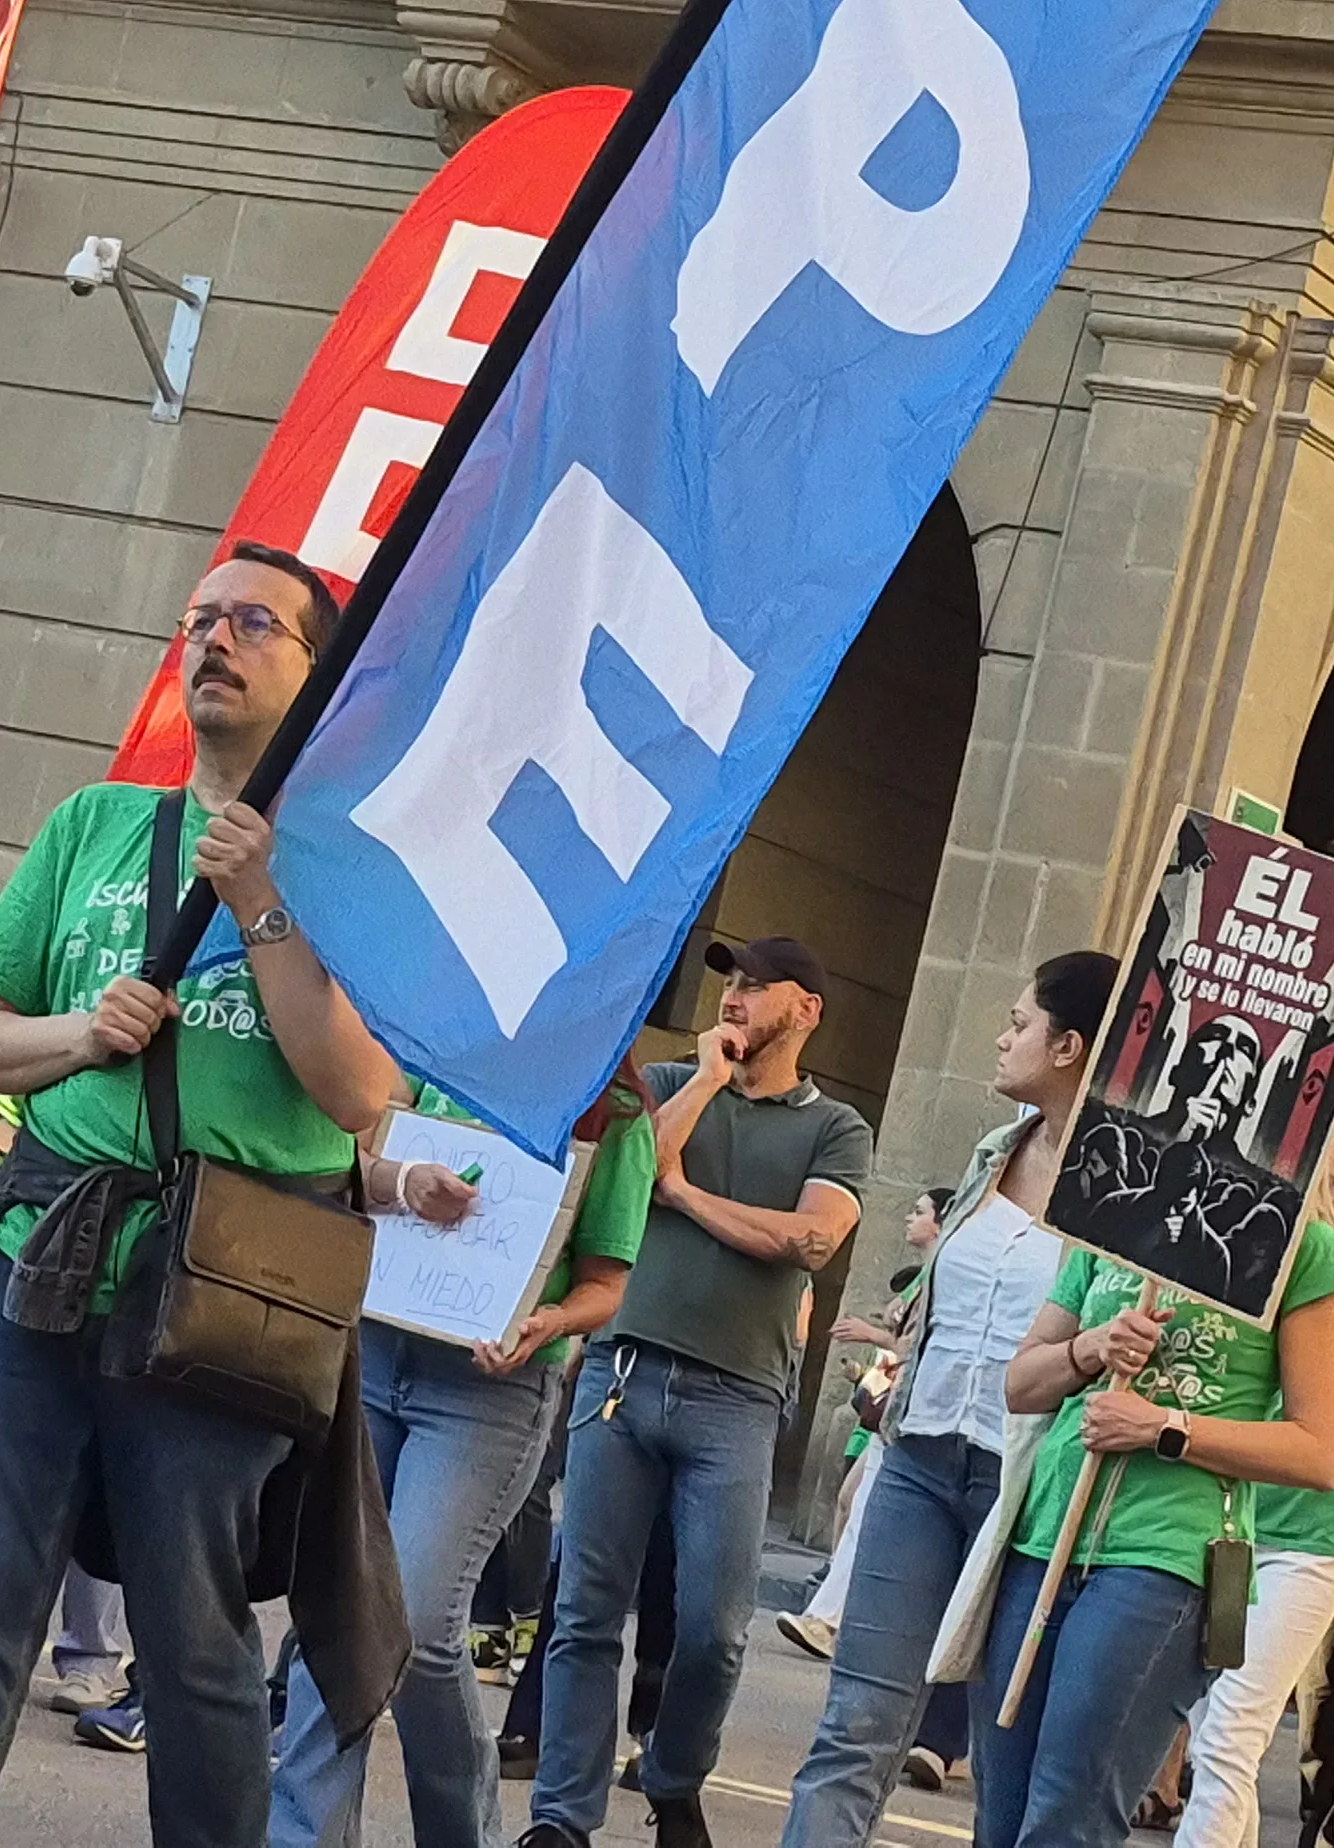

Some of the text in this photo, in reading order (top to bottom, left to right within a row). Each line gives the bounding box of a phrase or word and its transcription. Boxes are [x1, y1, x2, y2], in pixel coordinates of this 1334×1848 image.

[1234, 846, 1320, 931] ÉL
[98, 947, 143, 976] DE
[1216, 909, 1316, 968] habló
[1181, 973, 1316, 1032] y se lo llevaron
[1182, 942, 1329, 1009] en mi nombre
[407, 1263, 496, 1316] MIEDO
